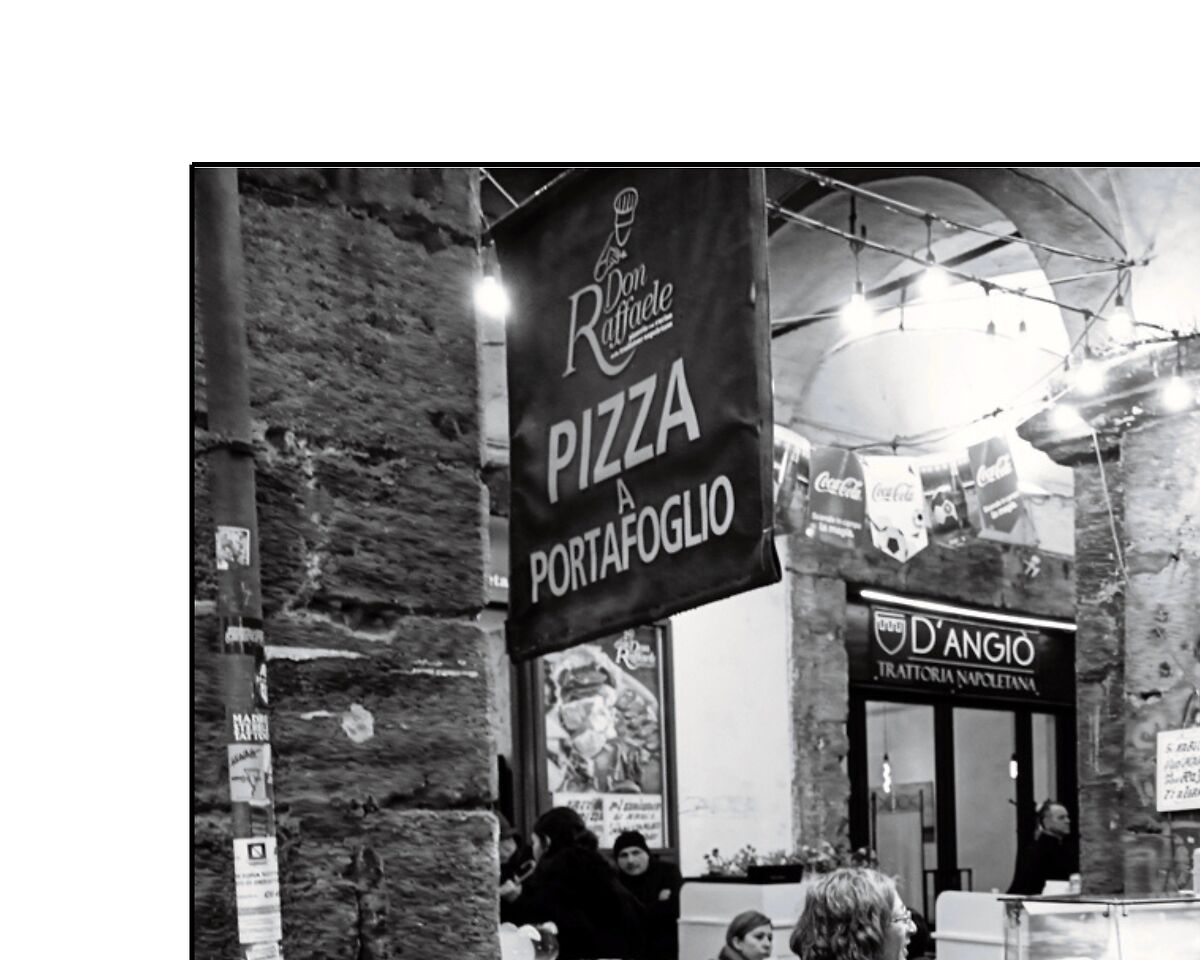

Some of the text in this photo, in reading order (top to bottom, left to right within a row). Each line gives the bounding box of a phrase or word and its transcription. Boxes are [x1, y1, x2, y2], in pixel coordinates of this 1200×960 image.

[603, 263, 646, 314] Don
[562, 280, 673, 378] Raffaele
[548, 357, 700, 504] PIZZA
[616, 478, 636, 514] A
[530, 475, 735, 604] PORTAFOGLIO
[911, 615, 1035, 666] D'ANGIÒ
[878, 661, 1037, 692] TRATTORIA NAPOLETANA
